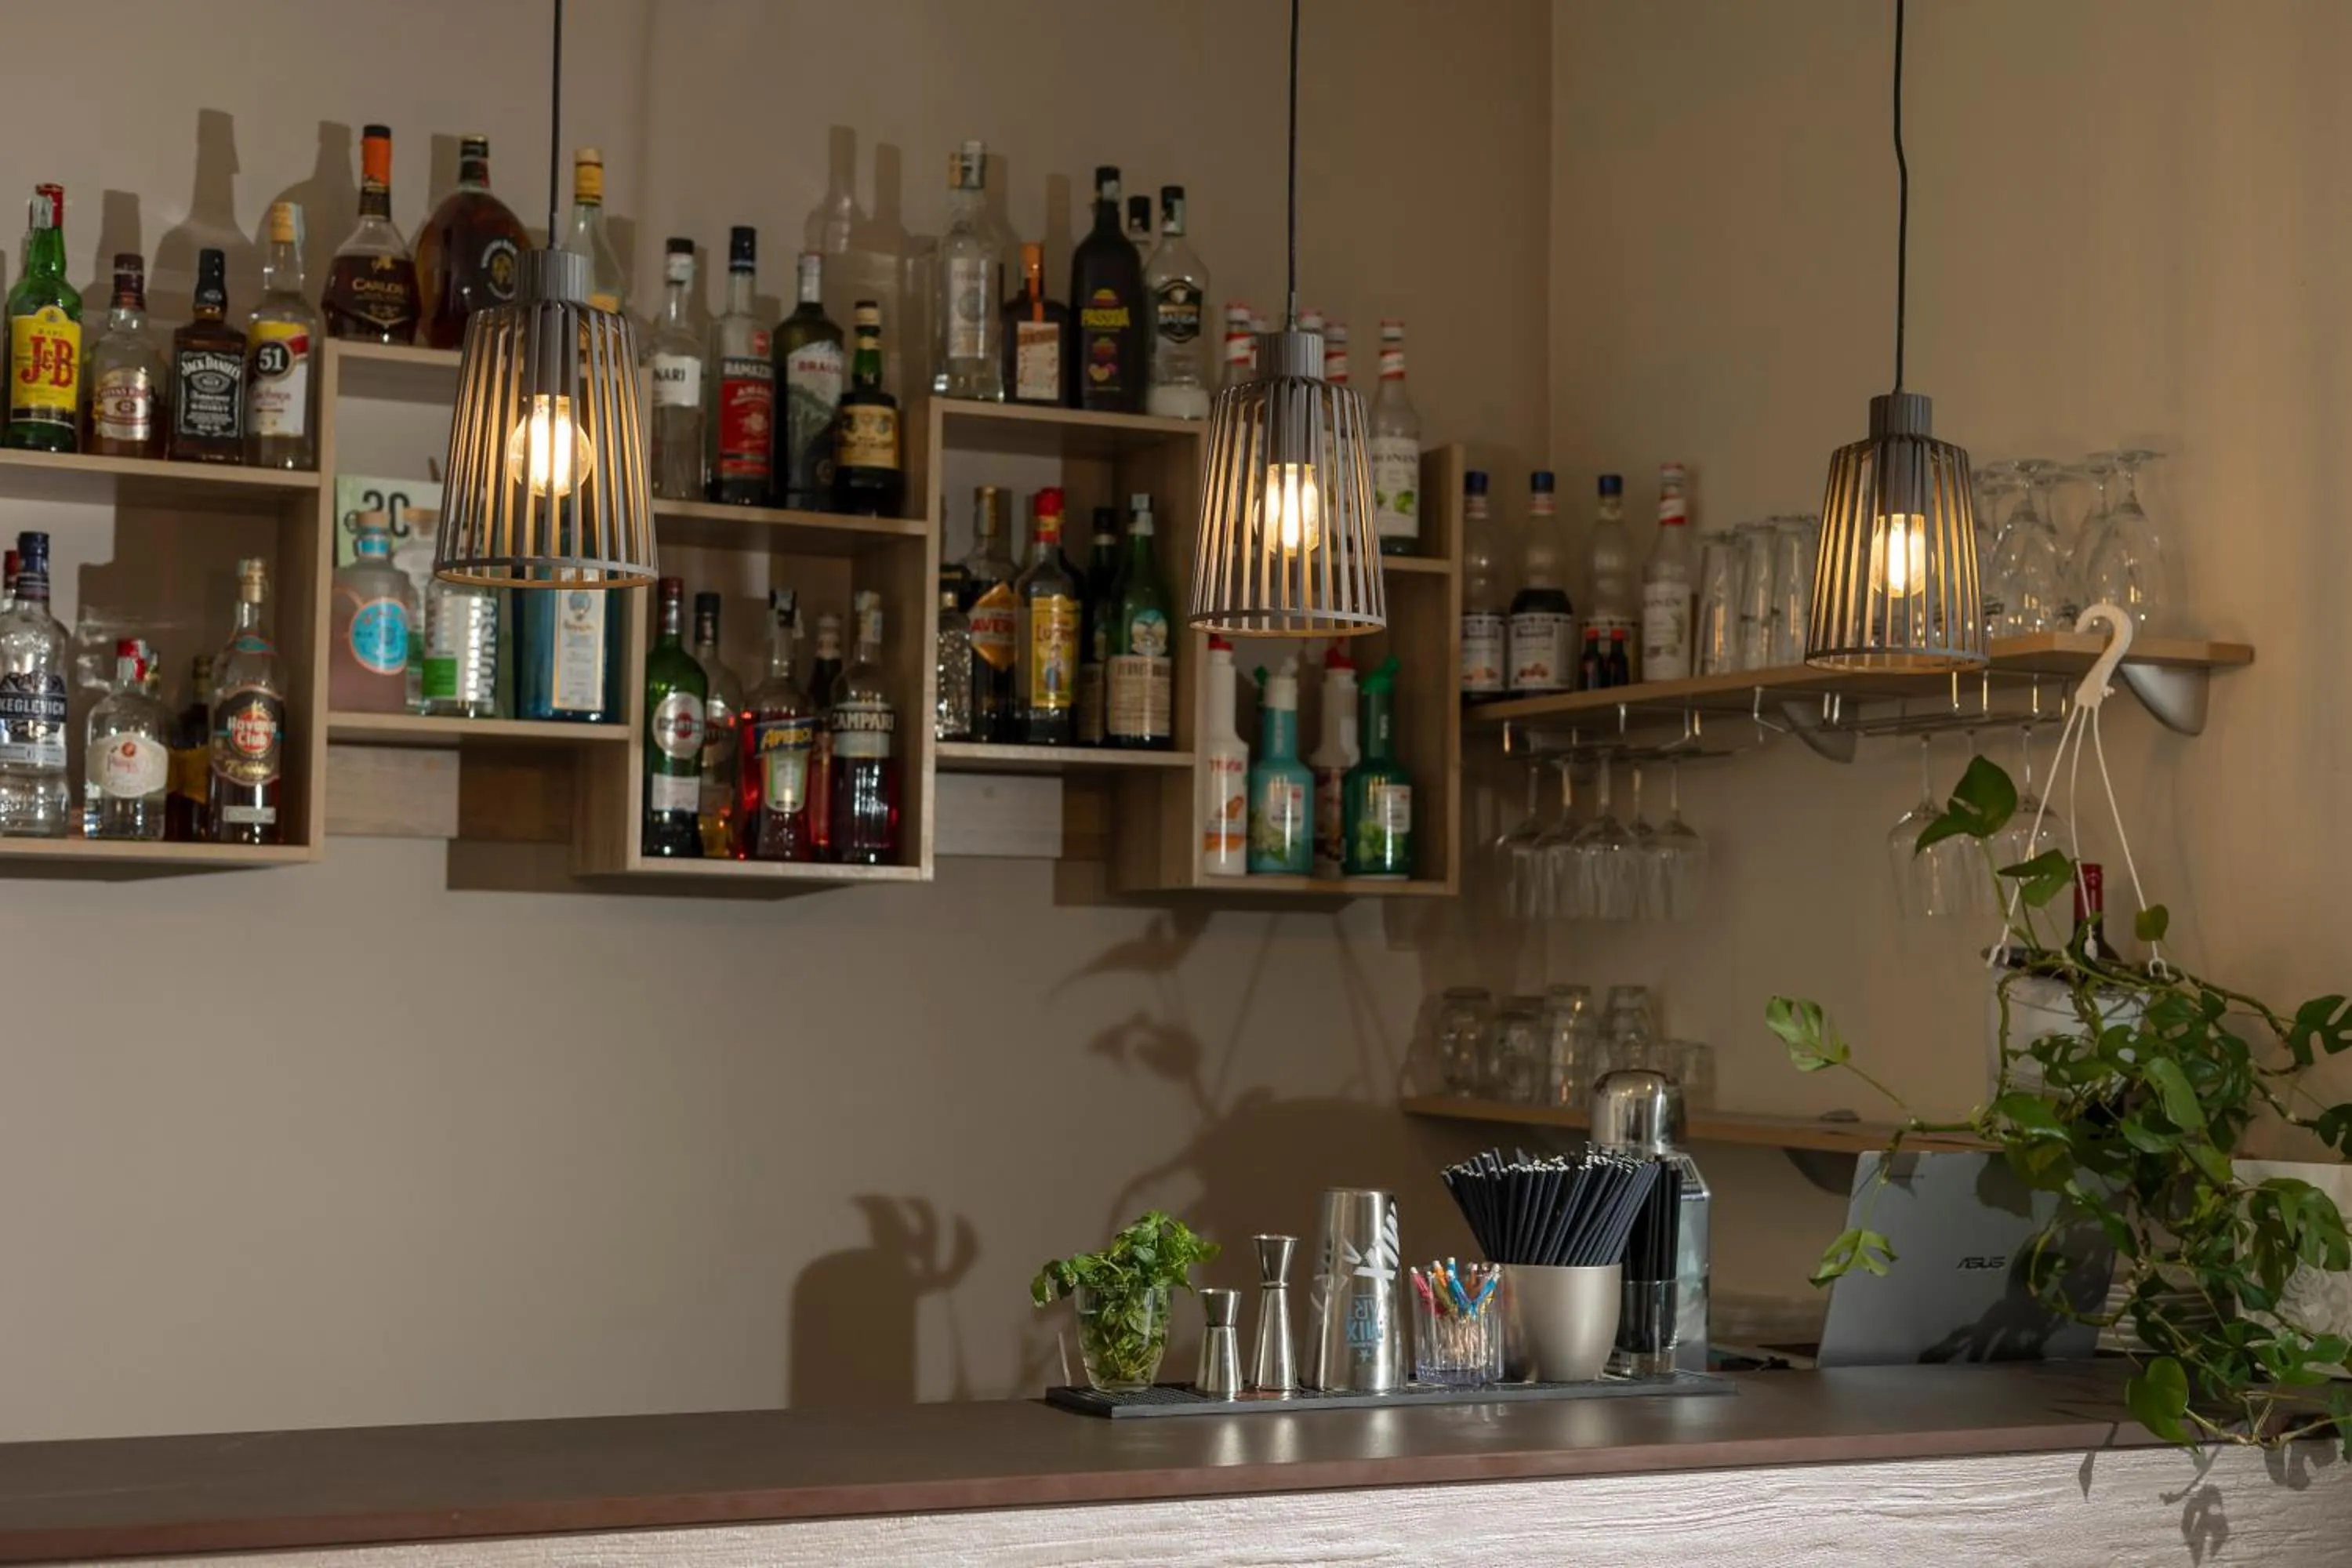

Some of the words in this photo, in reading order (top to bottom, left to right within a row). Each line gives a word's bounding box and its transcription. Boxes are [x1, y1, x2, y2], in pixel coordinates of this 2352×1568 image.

[20, 335, 74, 387] J&B
[258, 347, 284, 372] 51
[831, 711, 895, 731] CAMPARI
[1956, 1256, 2006, 1269] ASUS
